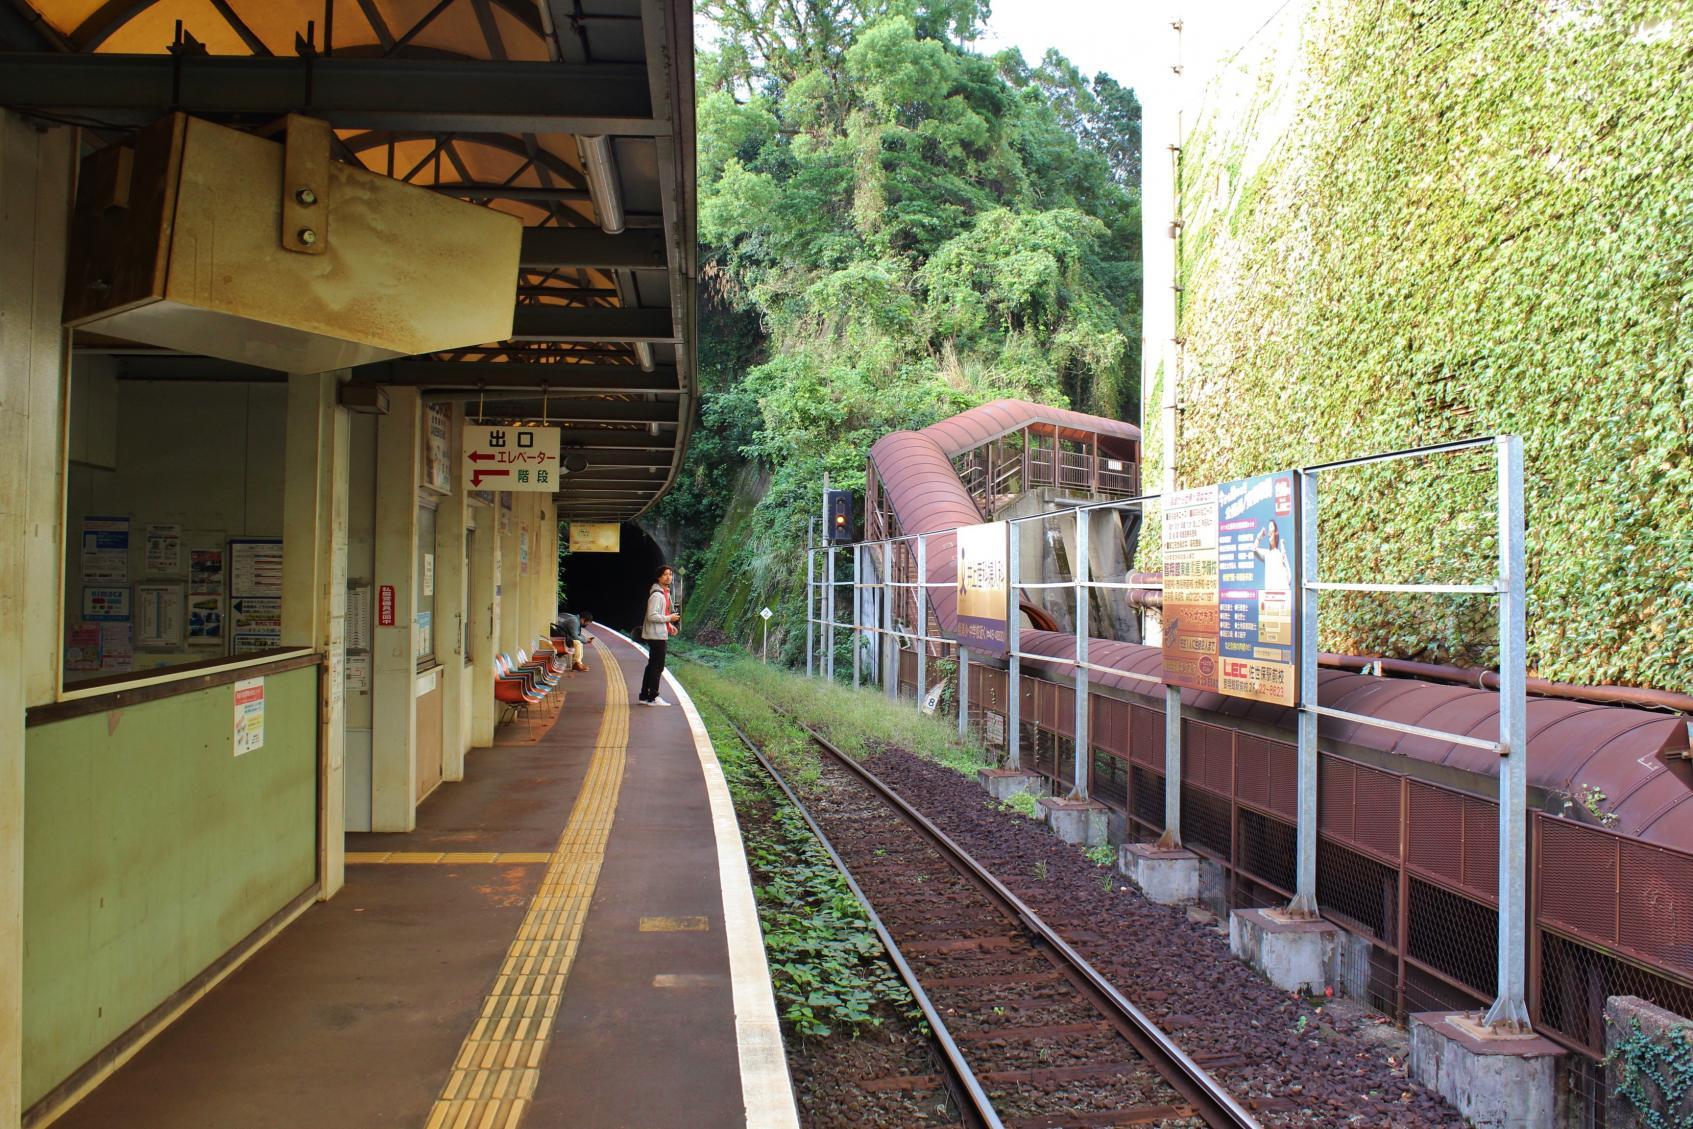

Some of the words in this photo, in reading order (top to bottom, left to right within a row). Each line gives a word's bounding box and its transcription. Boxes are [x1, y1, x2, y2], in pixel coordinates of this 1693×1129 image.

[489, 429, 534, 448] 出口
[497, 451, 556, 464] エレベーター
[517, 469, 549, 484] 階段
[1223, 659, 1248, 679] LEC
[1249, 665, 1285, 684] 佐世保駅前校
[928, 698, 935, 707] 8
